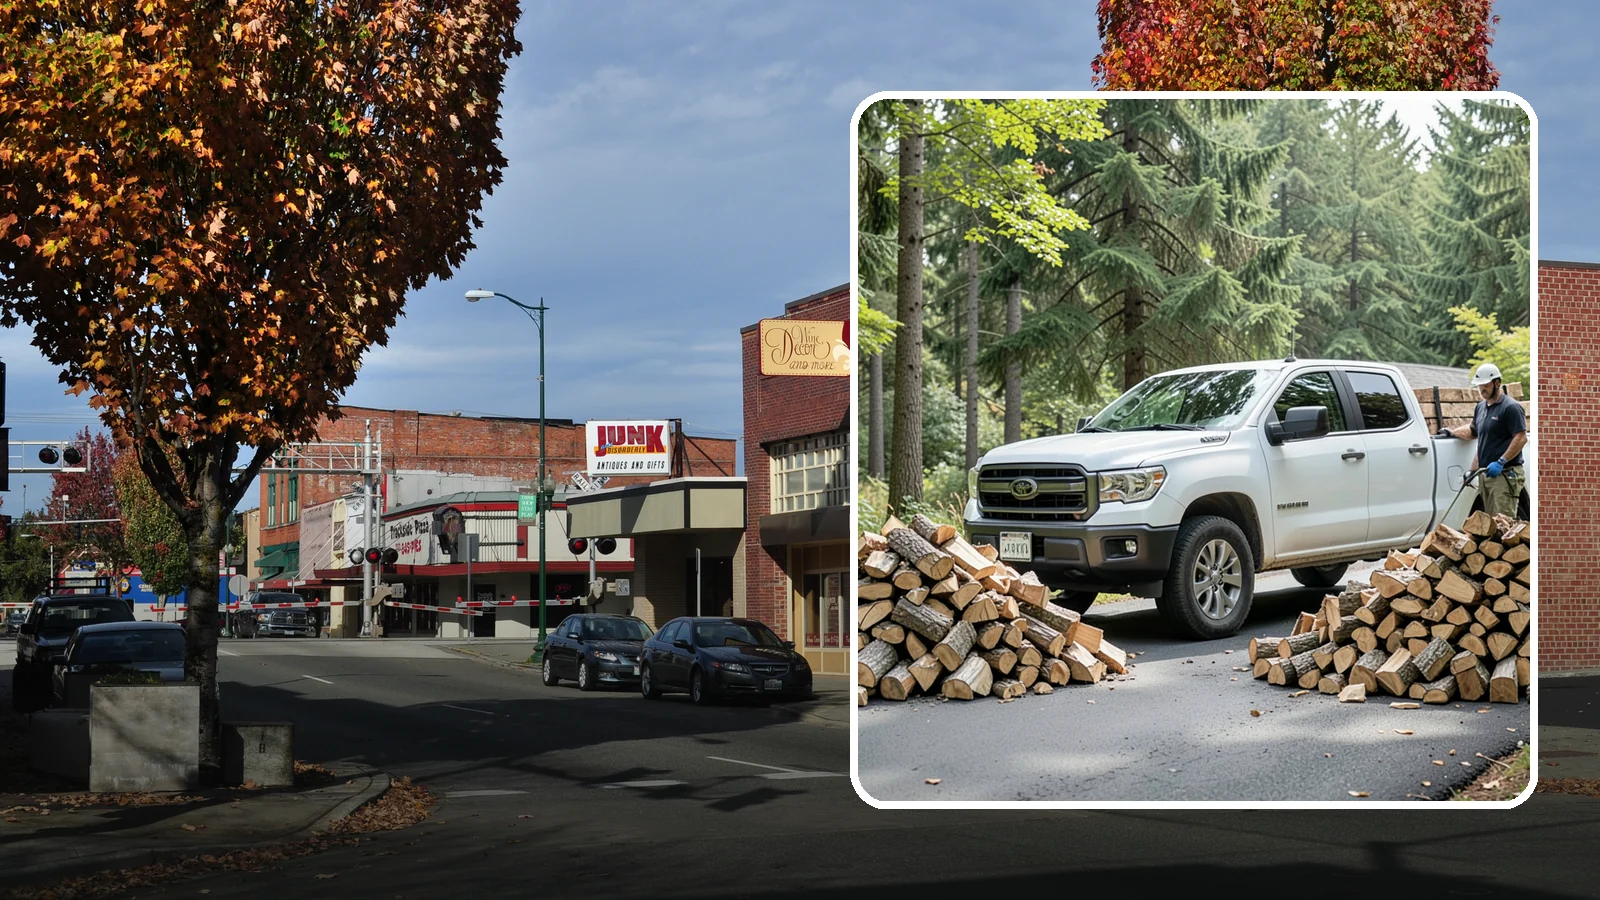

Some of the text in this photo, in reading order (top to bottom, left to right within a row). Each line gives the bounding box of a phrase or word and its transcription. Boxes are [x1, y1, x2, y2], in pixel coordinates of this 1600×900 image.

[595, 425, 665, 457] JUNK
[607, 446, 646, 454] DISORDERLY
[597, 460, 665, 470] ANTIQUES AND GIFTS
[415, 520, 429, 534] Pizza
